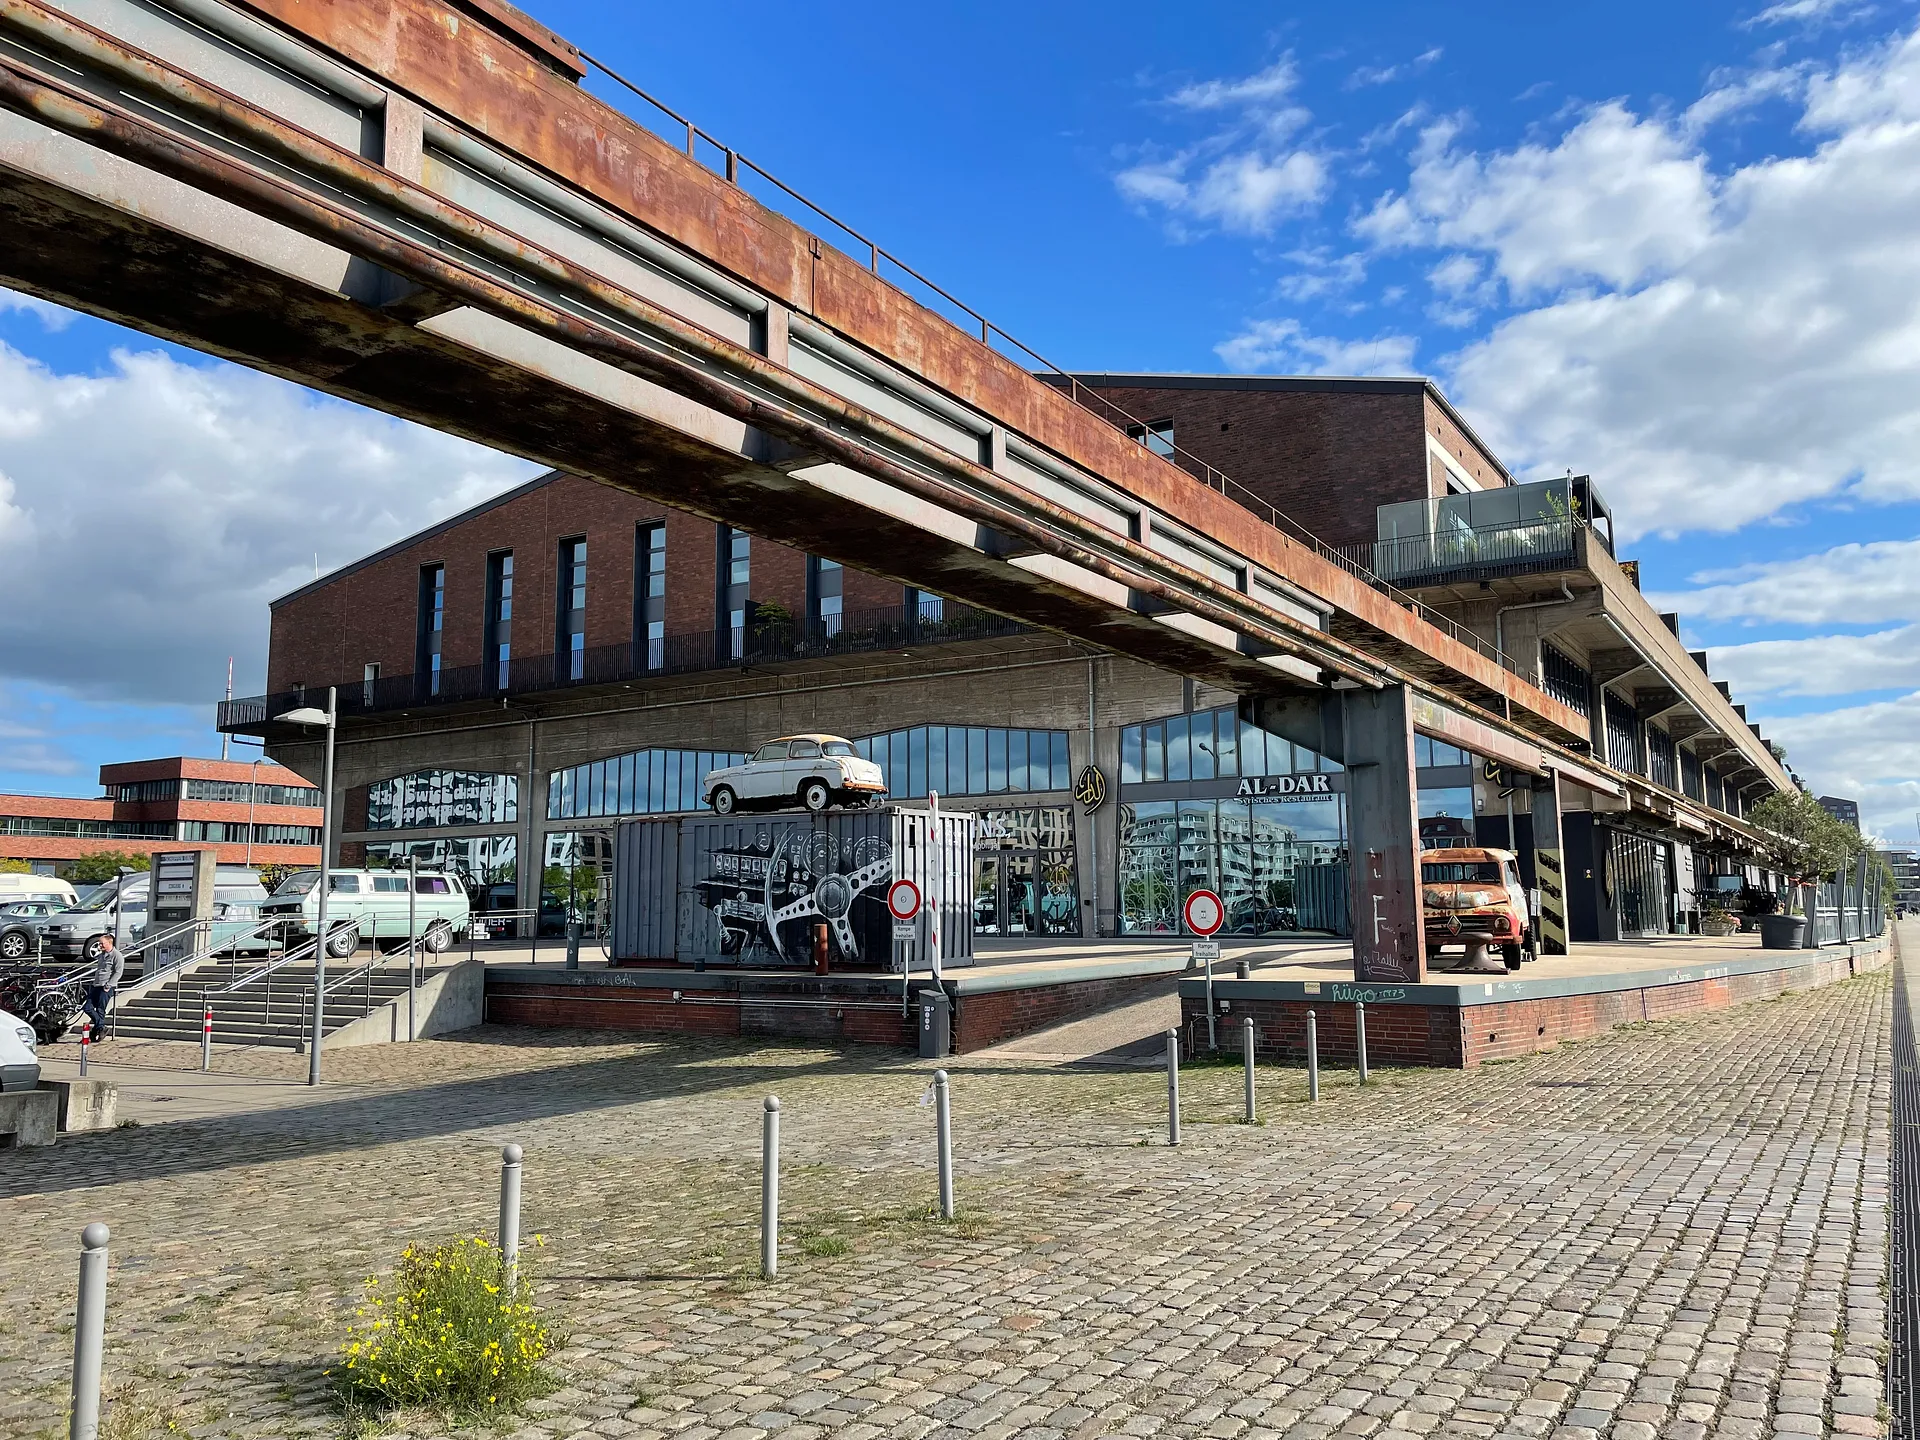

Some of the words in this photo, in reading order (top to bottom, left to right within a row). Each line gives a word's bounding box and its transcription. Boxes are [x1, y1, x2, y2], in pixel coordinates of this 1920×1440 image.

[1236, 774, 1331, 796] AL-DAR
[1238, 797, 1280, 806] Syrisches
[1281, 794, 1333, 804] Restaurant
